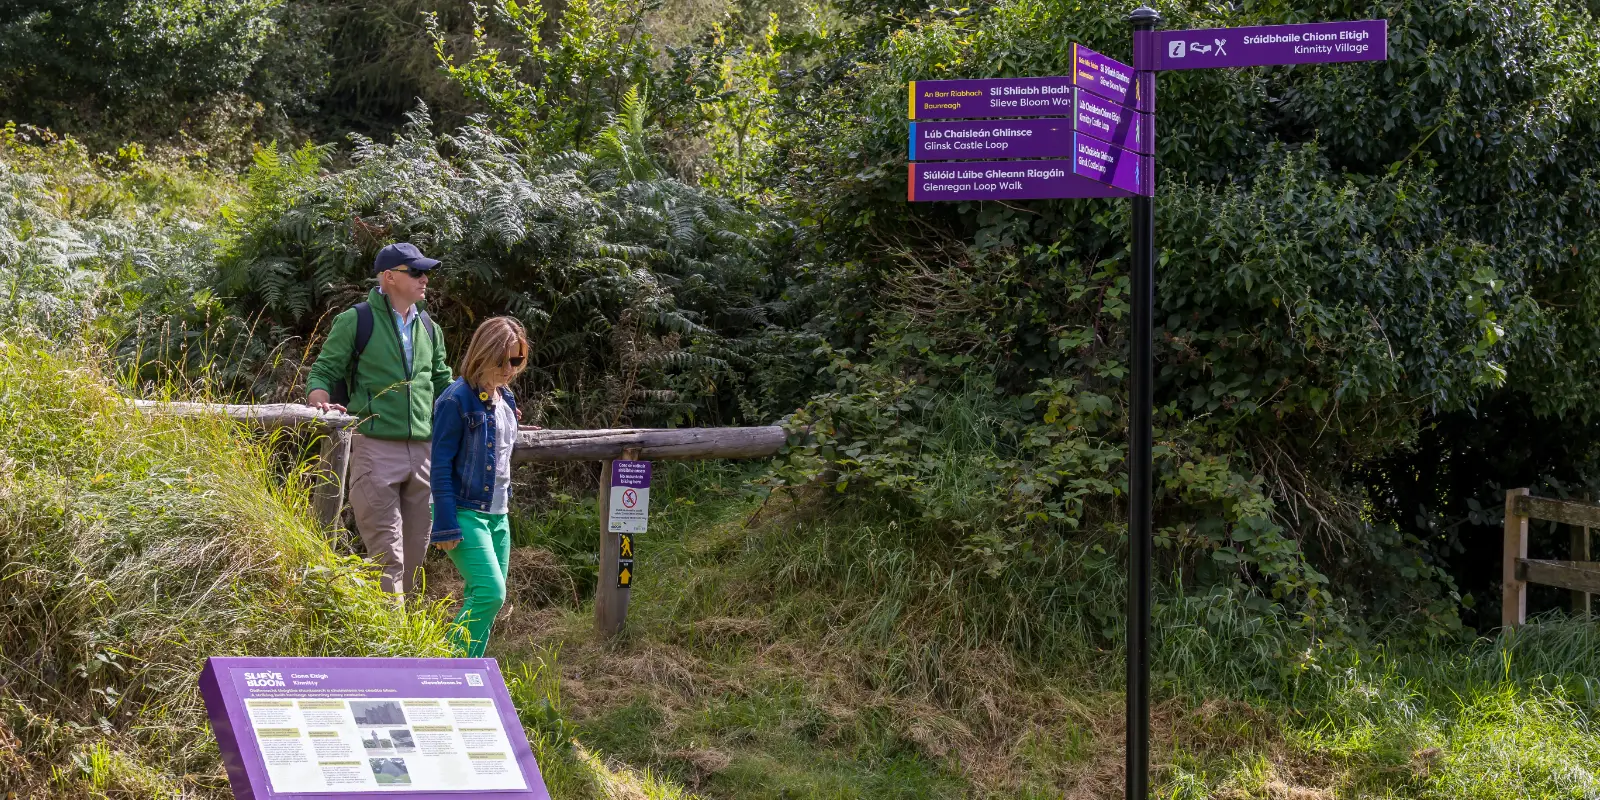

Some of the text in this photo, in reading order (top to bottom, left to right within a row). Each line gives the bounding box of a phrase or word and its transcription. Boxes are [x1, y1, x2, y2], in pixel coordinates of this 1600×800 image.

[1243, 30, 1369, 44] Sráidbhaile Chionn Eitigh
[1294, 43, 1369, 54] Kinnitty Village
[935, 90, 949, 98] Barr
[951, 89, 983, 97] Riabhach
[990, 86, 1002, 96] Slí
[1003, 86, 1040, 96] Shliabh
[924, 102, 961, 110] Baunreagh
[990, 97, 1071, 108] Slieve Bloom Way
[924, 128, 1033, 139] Lúb Chaisleán Ghlinsce
[924, 140, 1009, 151] Glinsk Castle Loop
[923, 168, 1065, 180] Siúlóid Lúibe Ghleann Riagáin
[923, 181, 1023, 193] Glenregan Loop Walk
[244, 672, 284, 680] SLIEVE
